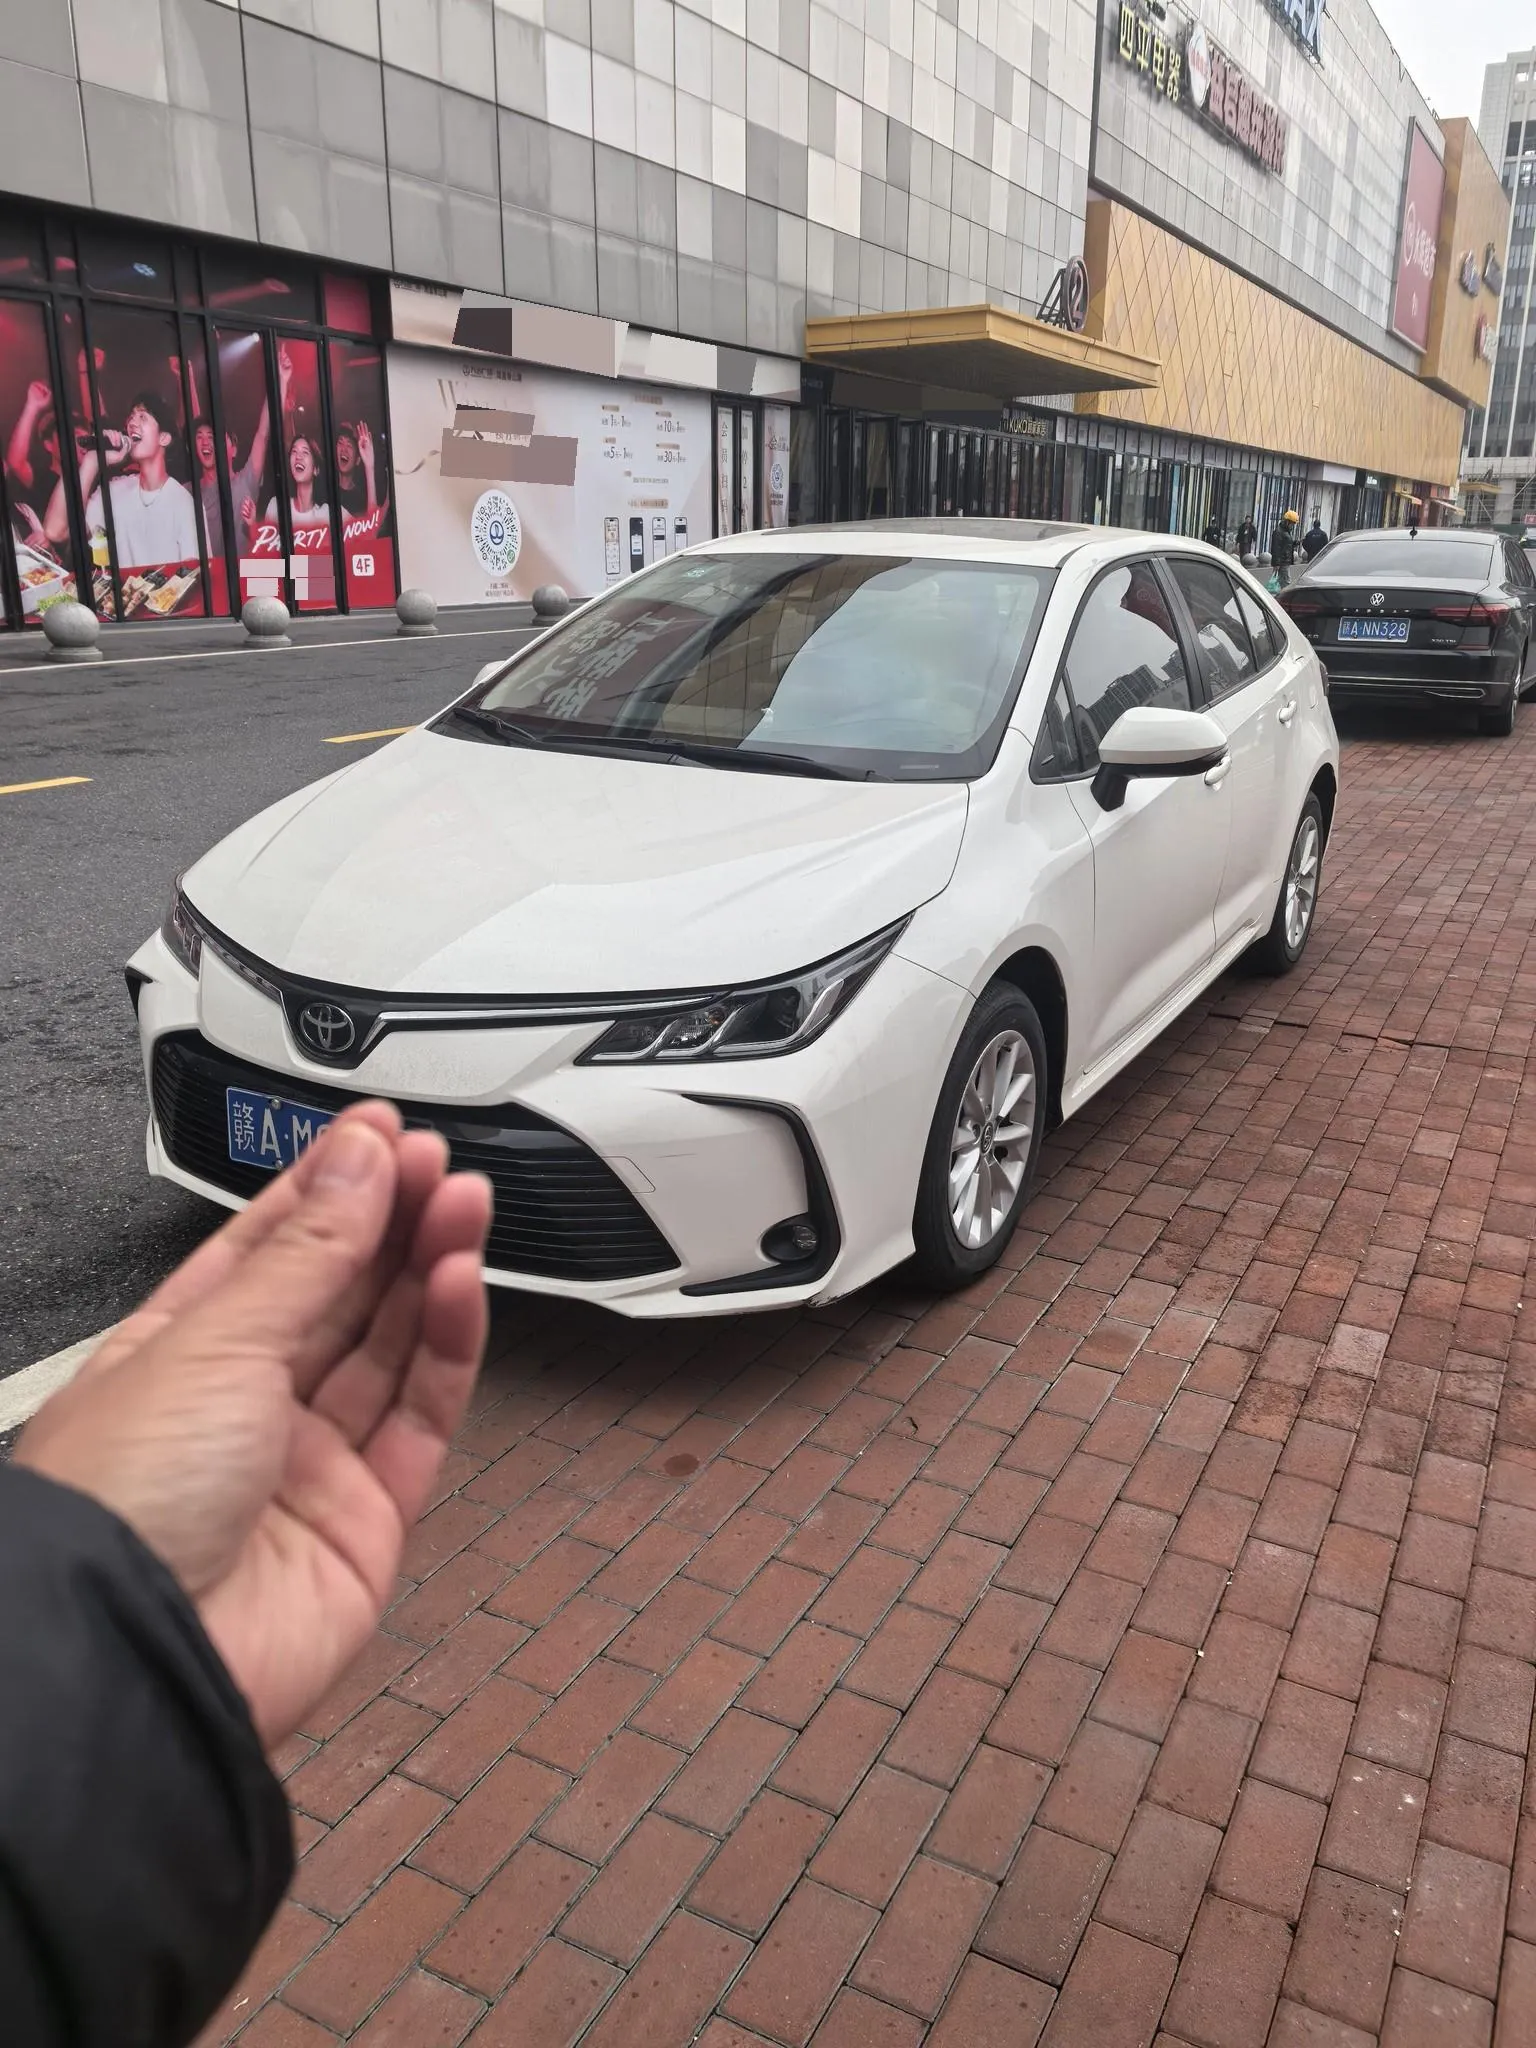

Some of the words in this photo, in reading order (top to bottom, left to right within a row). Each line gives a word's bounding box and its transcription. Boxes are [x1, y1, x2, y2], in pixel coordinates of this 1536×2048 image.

[1119, 6, 1181, 102] 四平电器
[251, 525, 328, 554] PARTY
[343, 510, 380, 542] NOW!
[355, 558, 371, 573] 4F
